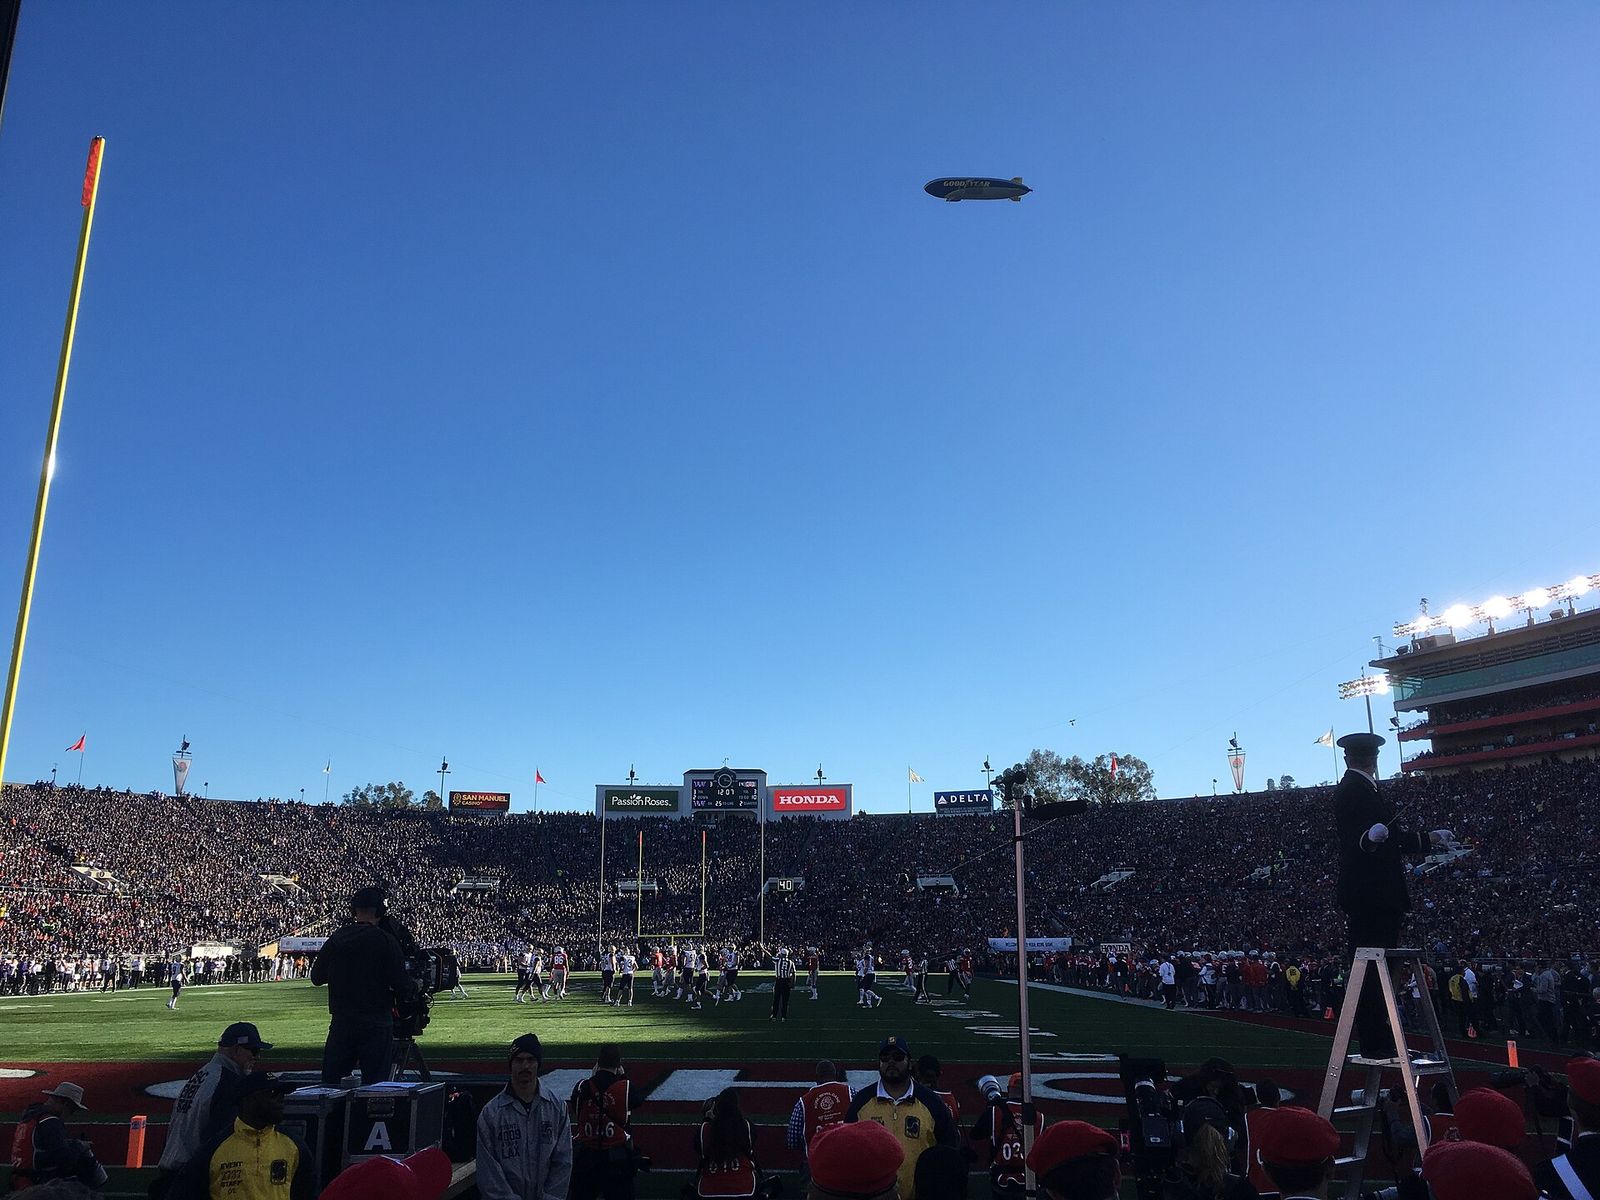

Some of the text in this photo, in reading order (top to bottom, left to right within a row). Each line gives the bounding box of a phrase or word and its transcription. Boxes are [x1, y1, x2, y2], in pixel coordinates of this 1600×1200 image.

[943, 180, 991, 188] GOODYEAR
[611, 796, 644, 806] Passion
[779, 795, 840, 805] HONDA
[950, 793, 989, 803] DELTA
[779, 880, 792, 890] 40
[1101, 944, 1131, 954] HONDA
[584, 1121, 615, 1138] 06
[364, 1121, 393, 1150] A
